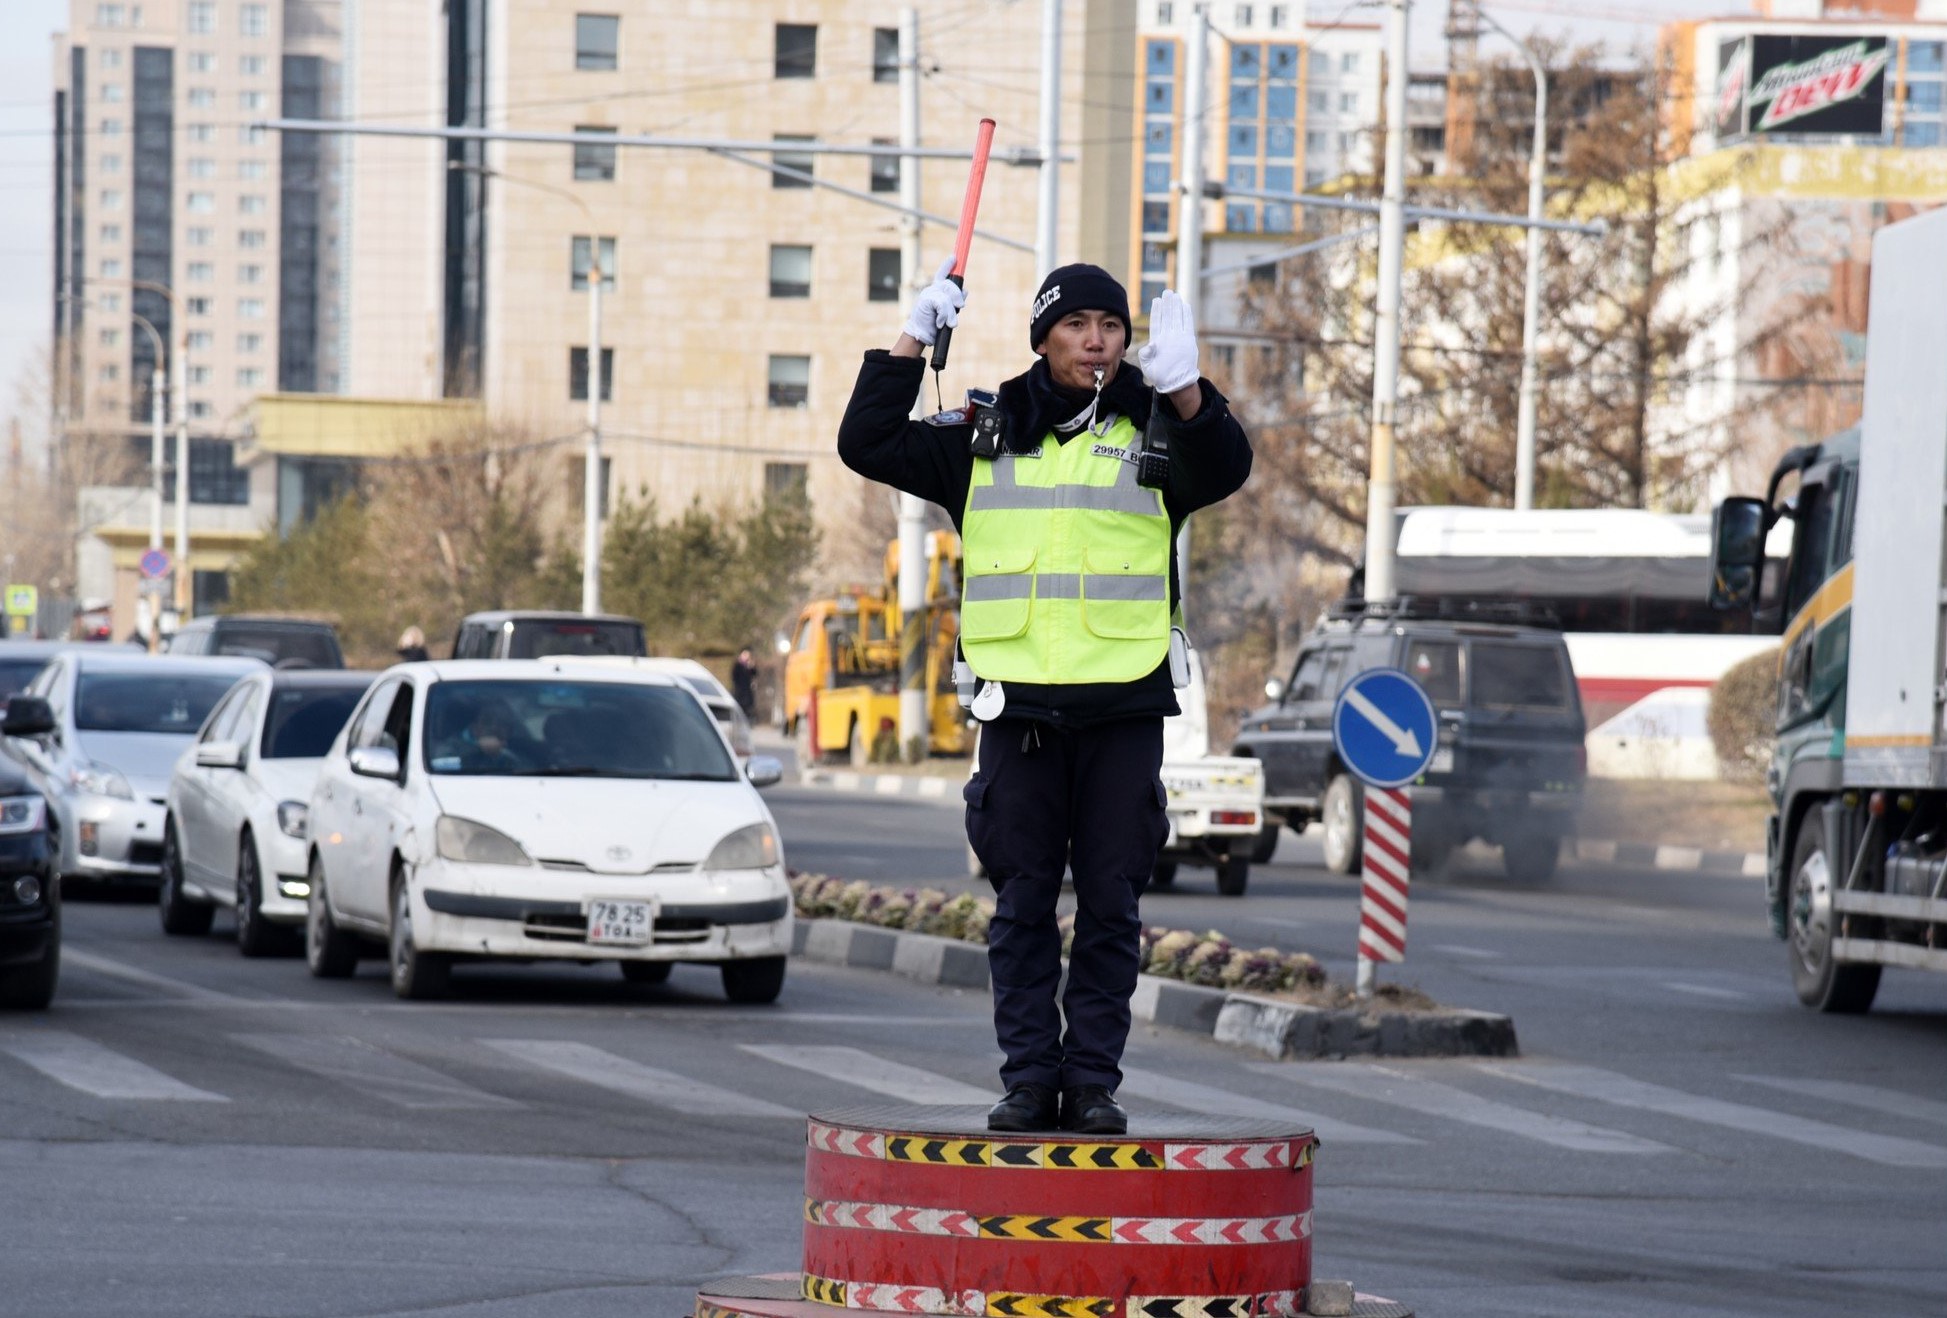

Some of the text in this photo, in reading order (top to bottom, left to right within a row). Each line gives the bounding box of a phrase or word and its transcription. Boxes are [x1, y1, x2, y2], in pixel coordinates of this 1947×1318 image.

[1093, 444, 1127, 458] 29957
[596, 903, 646, 925] 78 25
